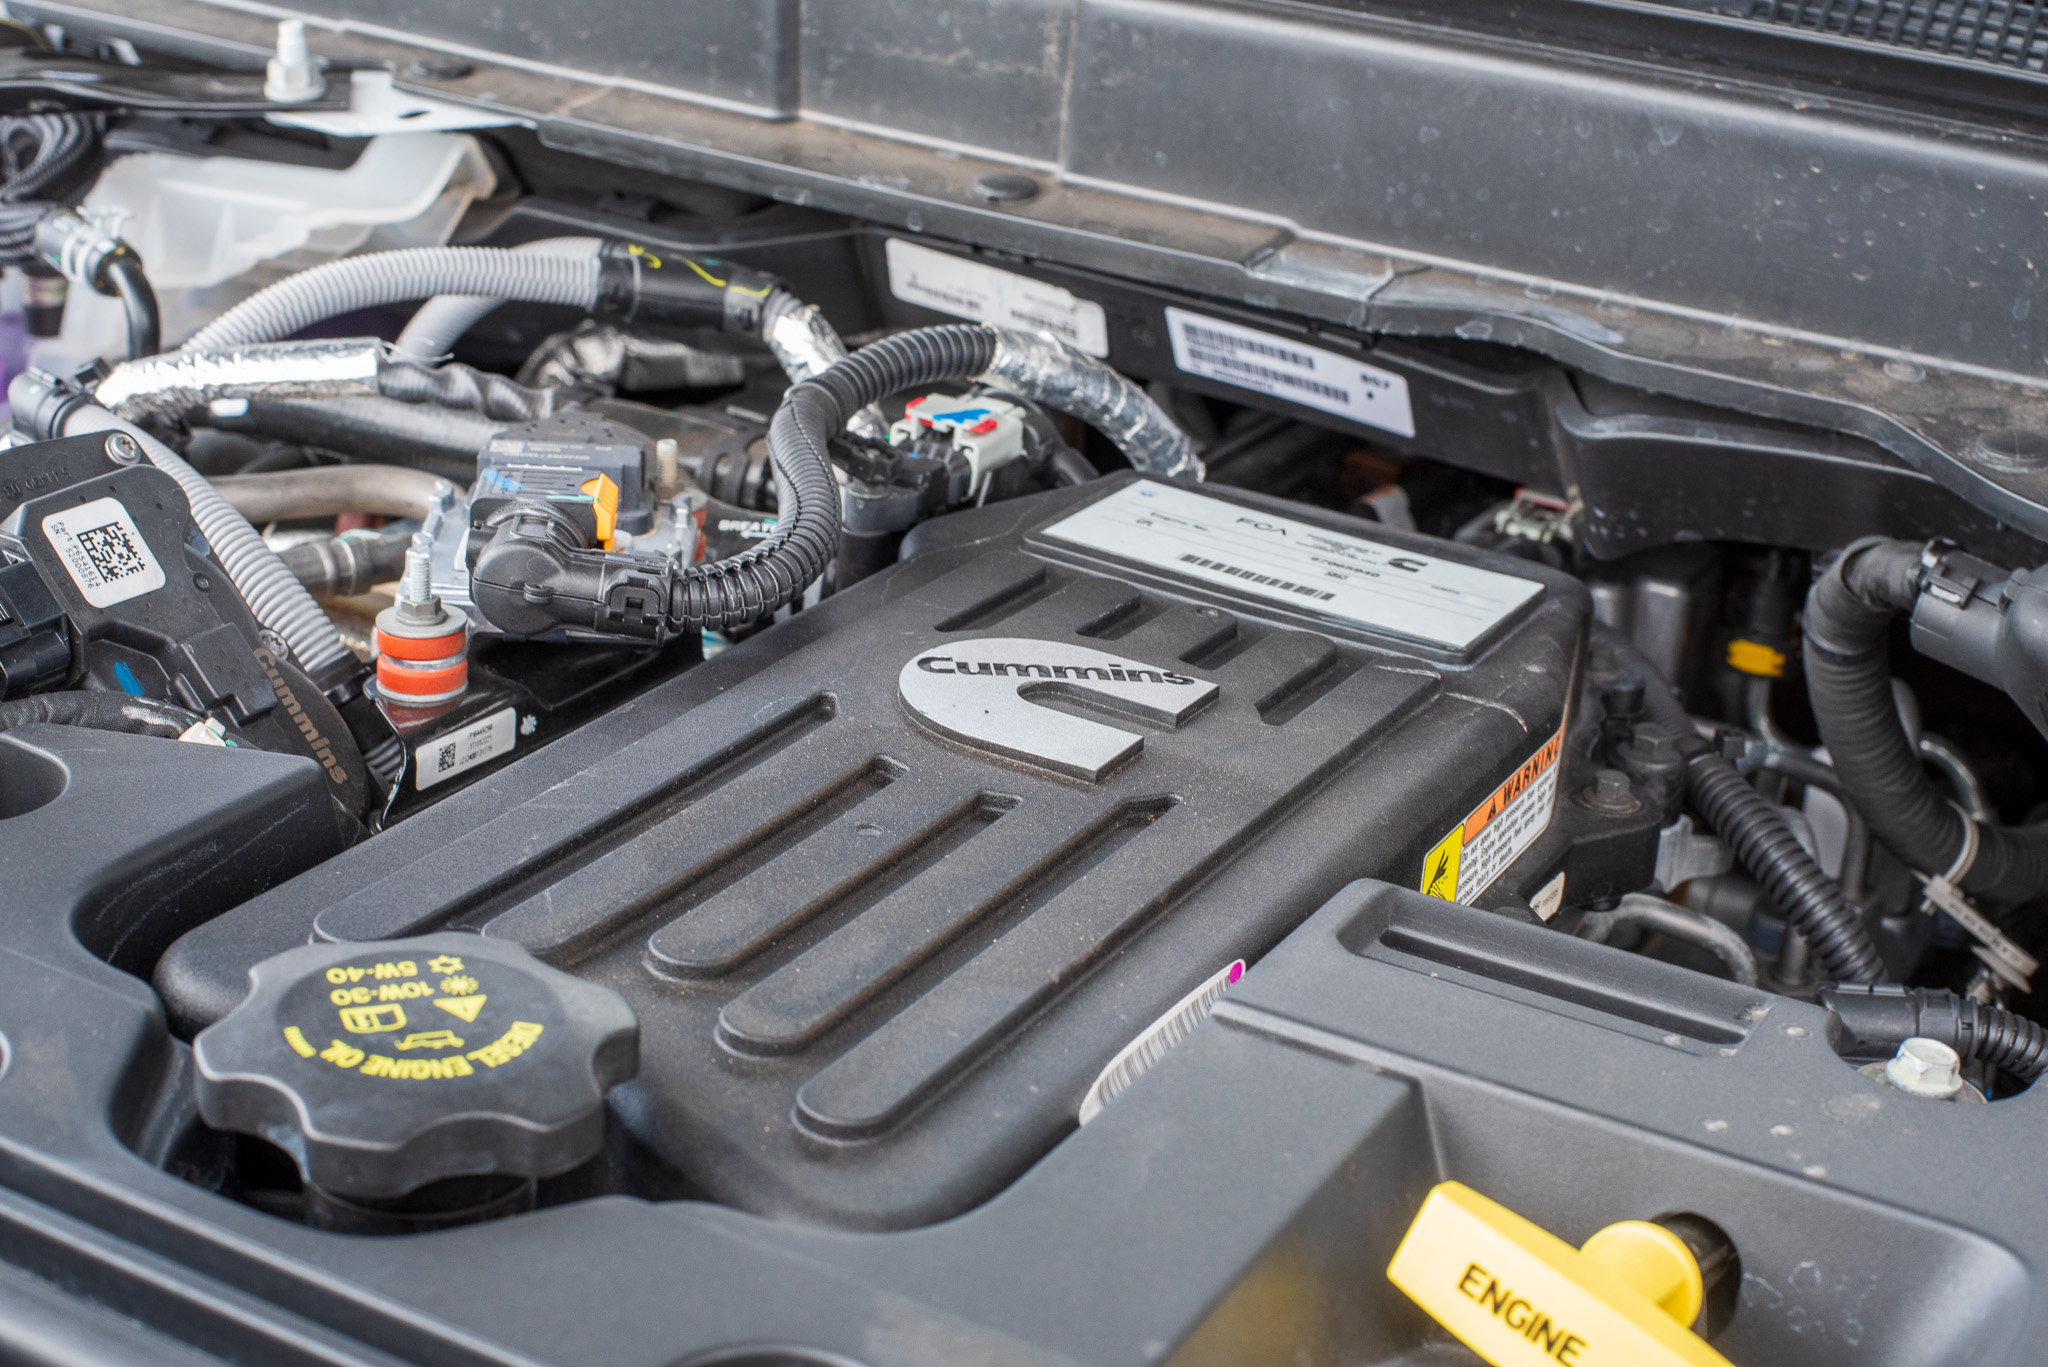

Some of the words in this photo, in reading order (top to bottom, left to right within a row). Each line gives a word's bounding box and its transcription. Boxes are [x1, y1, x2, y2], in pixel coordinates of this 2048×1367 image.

[718, 519, 777, 534] BREAT
[917, 655, 1195, 686] Cummins
[253, 648, 348, 785] Cummins
[326, 960, 418, 985] 5W-40
[330, 981, 435, 1006] 10W-30
[359, 1053, 475, 1080] ENGINE
[1457, 1261, 1589, 1367] ENGINE
